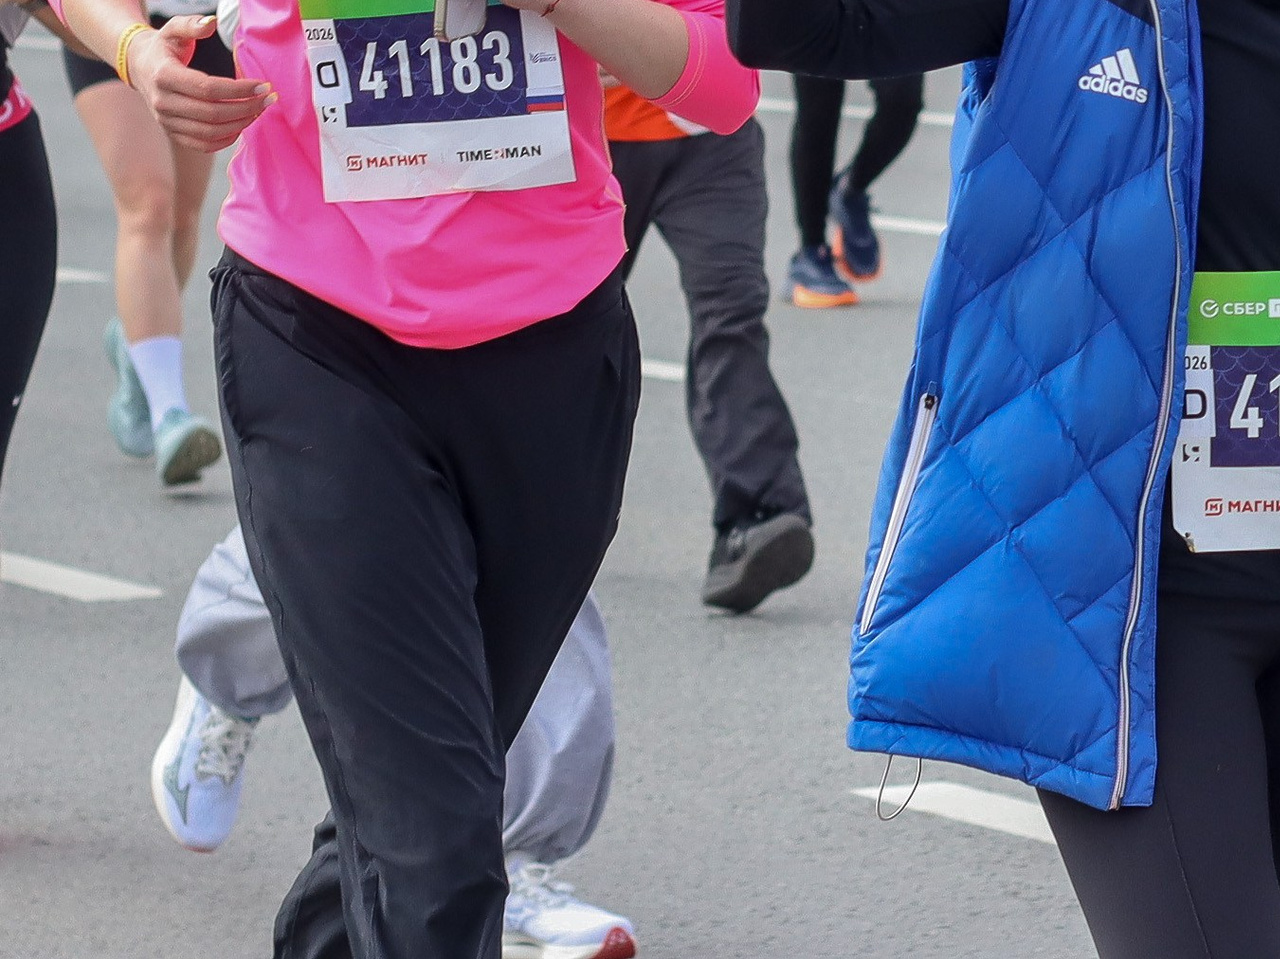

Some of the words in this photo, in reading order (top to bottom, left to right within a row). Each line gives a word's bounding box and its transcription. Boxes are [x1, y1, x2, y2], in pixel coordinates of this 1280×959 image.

[305, 28, 334, 41] 2026
[316, 61, 340, 88] D
[359, 30, 514, 100] 41183
[1079, 74, 1148, 103] adidas
[366, 153, 428, 168] МАГНИТ
[1223, 302, 1266, 315] СБЕР
[1184, 356, 1208, 370] 026
[1182, 389, 1207, 420] D
